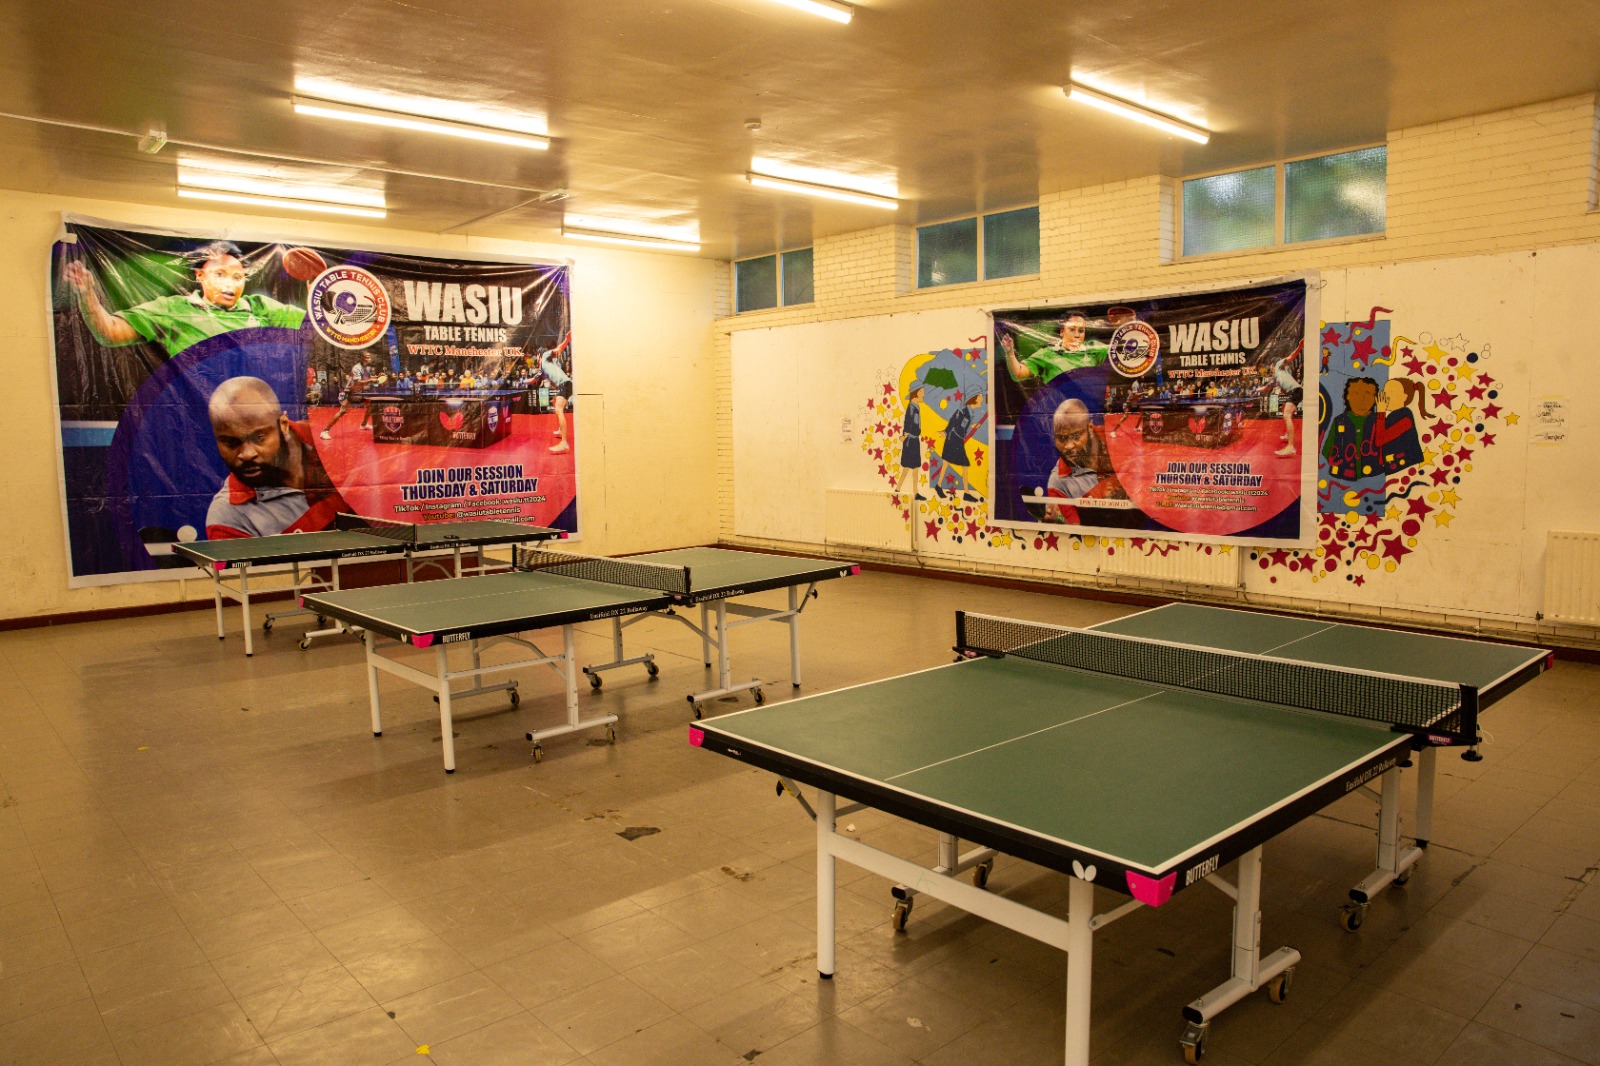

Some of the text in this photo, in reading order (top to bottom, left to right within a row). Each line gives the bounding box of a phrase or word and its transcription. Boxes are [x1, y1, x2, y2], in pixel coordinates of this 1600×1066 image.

[313, 271, 387, 323] WASIU TABLE TENNIS CLUB
[404, 280, 523, 325] WASIU
[423, 326, 508, 343] TABLE TENNIS
[1168, 316, 1260, 354] WASIU
[406, 344, 524, 357] WTTC Manchester UK.
[1180, 352, 1246, 368] TABLE TENNIS
[1168, 370, 1194, 378] WTTC
[1194, 368, 1241, 378] Manchester
[417, 465, 523, 484] JOIN OUR SESSION
[1167, 462, 1250, 475] JOIN OUR SESSION
[1156, 474, 1262, 488] THURSDAY & SATURDAY
[401, 478, 538, 501] THURSDAY & SATURDAY
[394, 504, 419, 512] TikTok
[426, 502, 462, 511] Instagram
[468, 499, 502, 508] Facebook:
[456, 507, 521, 519] @wasiutabletennis
[442, 632, 470, 643] BUTTERFLY
[1186, 854, 1220, 886] BUTTERFLY
